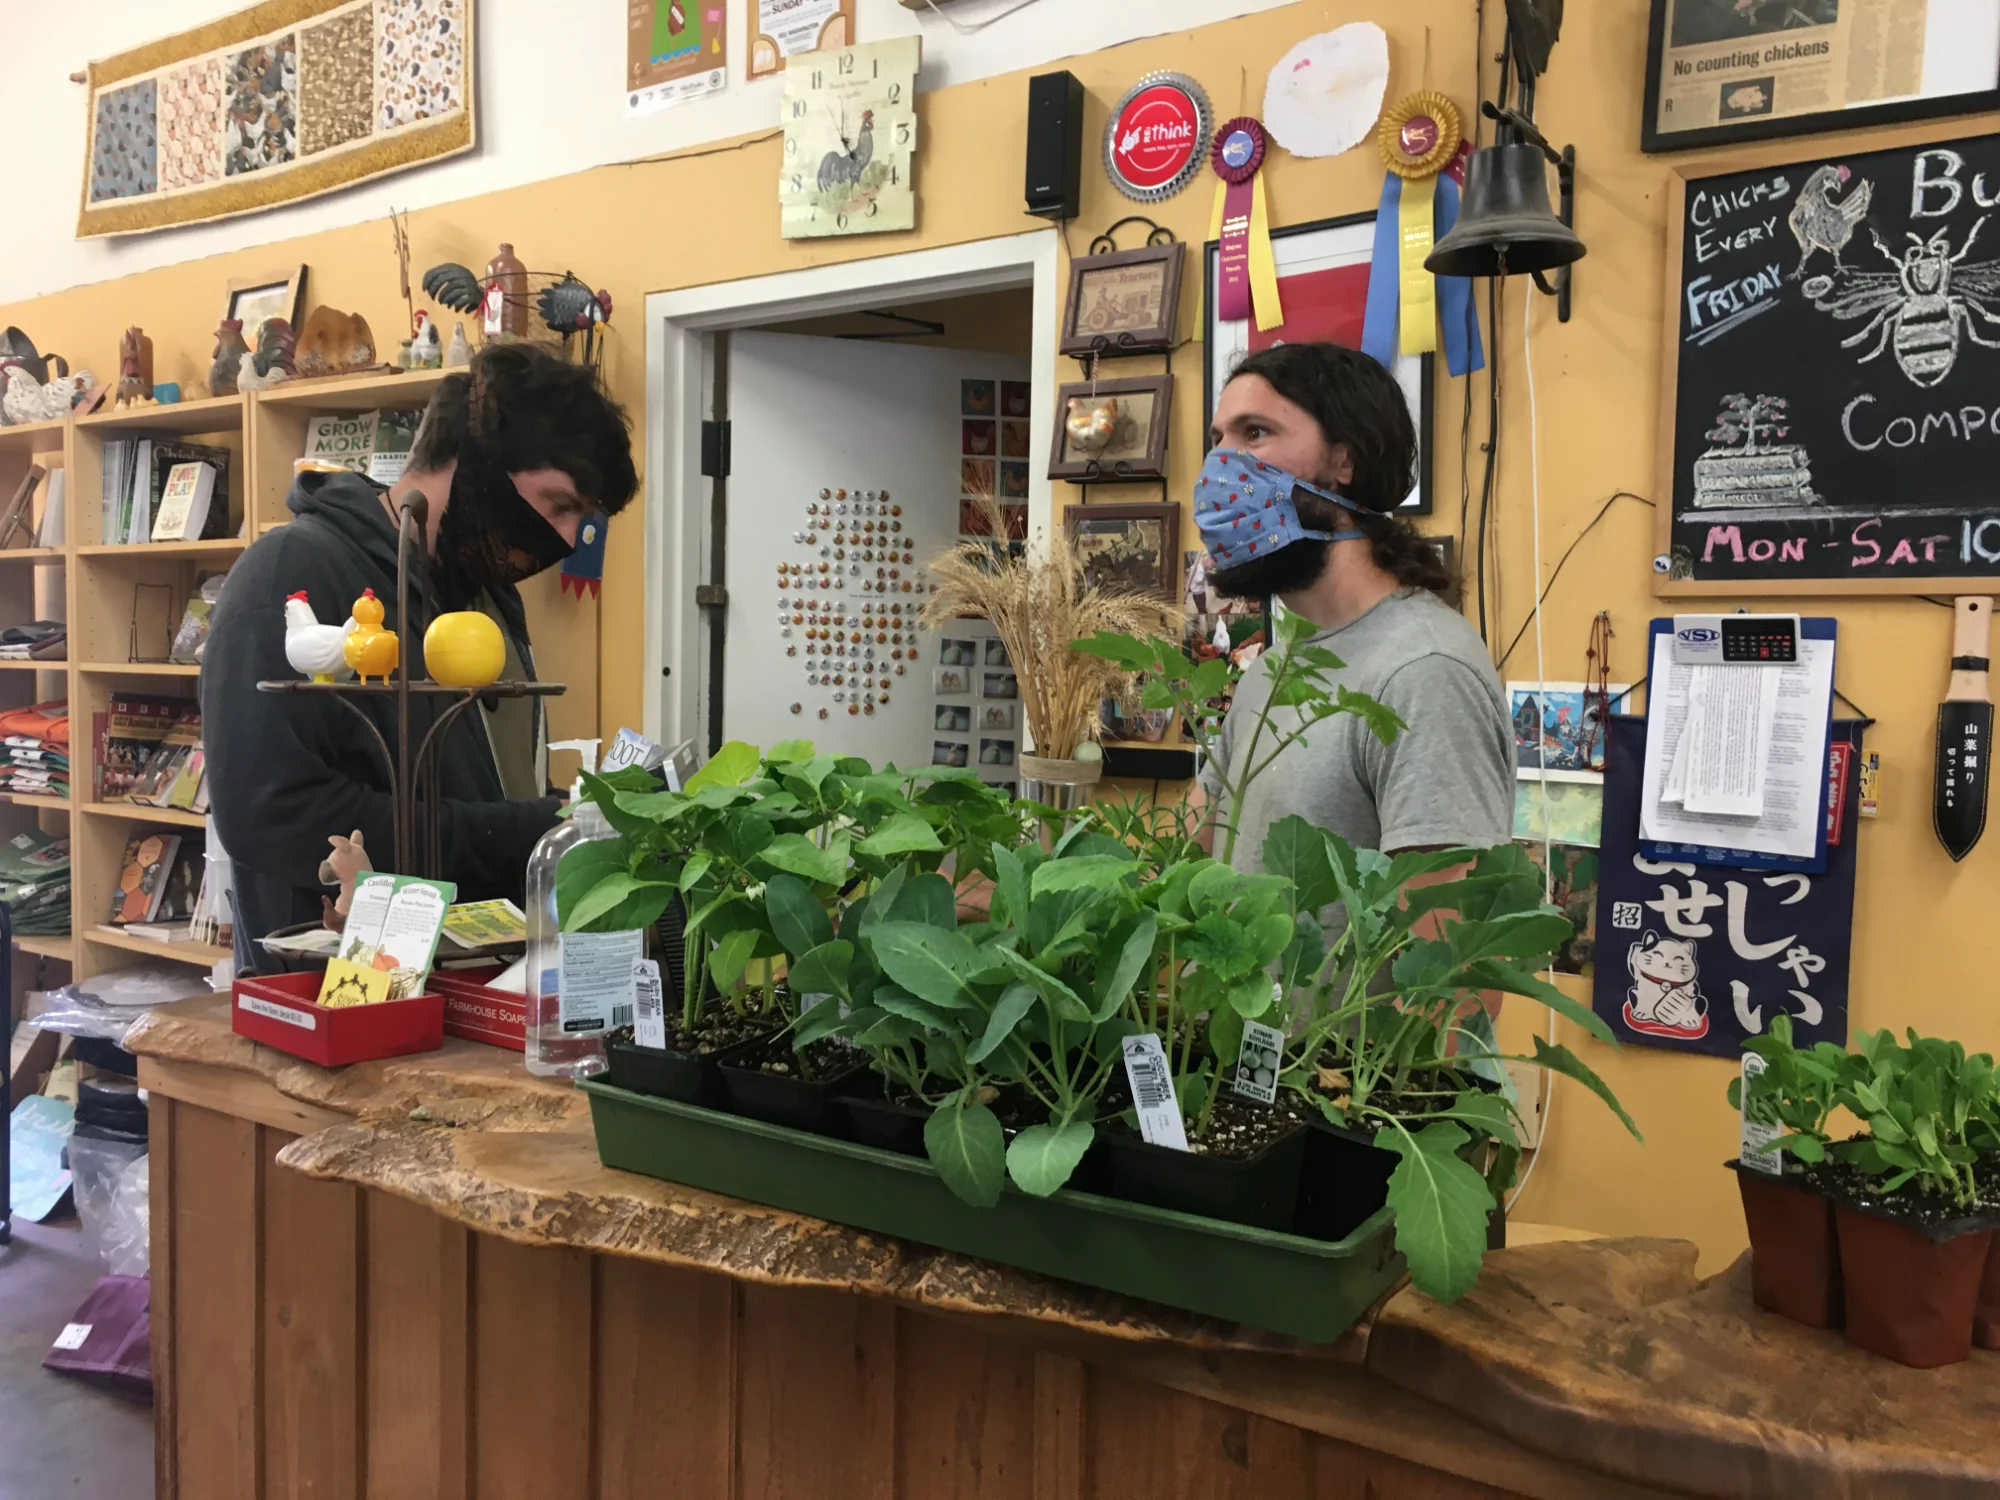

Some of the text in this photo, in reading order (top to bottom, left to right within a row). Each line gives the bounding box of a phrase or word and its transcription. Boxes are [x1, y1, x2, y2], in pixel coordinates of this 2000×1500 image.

[838, 53, 854, 75] 12
[1673, 59, 1692, 76] No
[1696, 50, 1760, 73] counting
[1764, 40, 1829, 63] chickens
[811, 70, 822, 90] 11
[888, 83, 900, 104] 2
[792, 101, 807, 118] 10
[895, 123, 909, 145] 3
[1151, 120, 1192, 141] think
[1690, 176, 1790, 227] CHICKS
[836, 211, 848, 229] 6
[1694, 216, 1777, 263] EVERY
[1686, 263, 1783, 329] FRIDAY
[317, 420, 372, 437] GROW
[314, 434, 371, 452] MORE
[167, 482, 194, 497] PLAY
[1701, 525, 1807, 563] MON
[1851, 518, 1950, 567] SAT
[1613, 903, 1641, 928] 招
[1724, 868, 1827, 1034] っしゃい
[448, 998, 497, 1019] FARMHOUSE
[1252, 1027, 1273, 1040] KONAN
[1156, 1055, 1172, 1100] CUCUMBER
[1155, 1083, 1165, 1103] Salad
